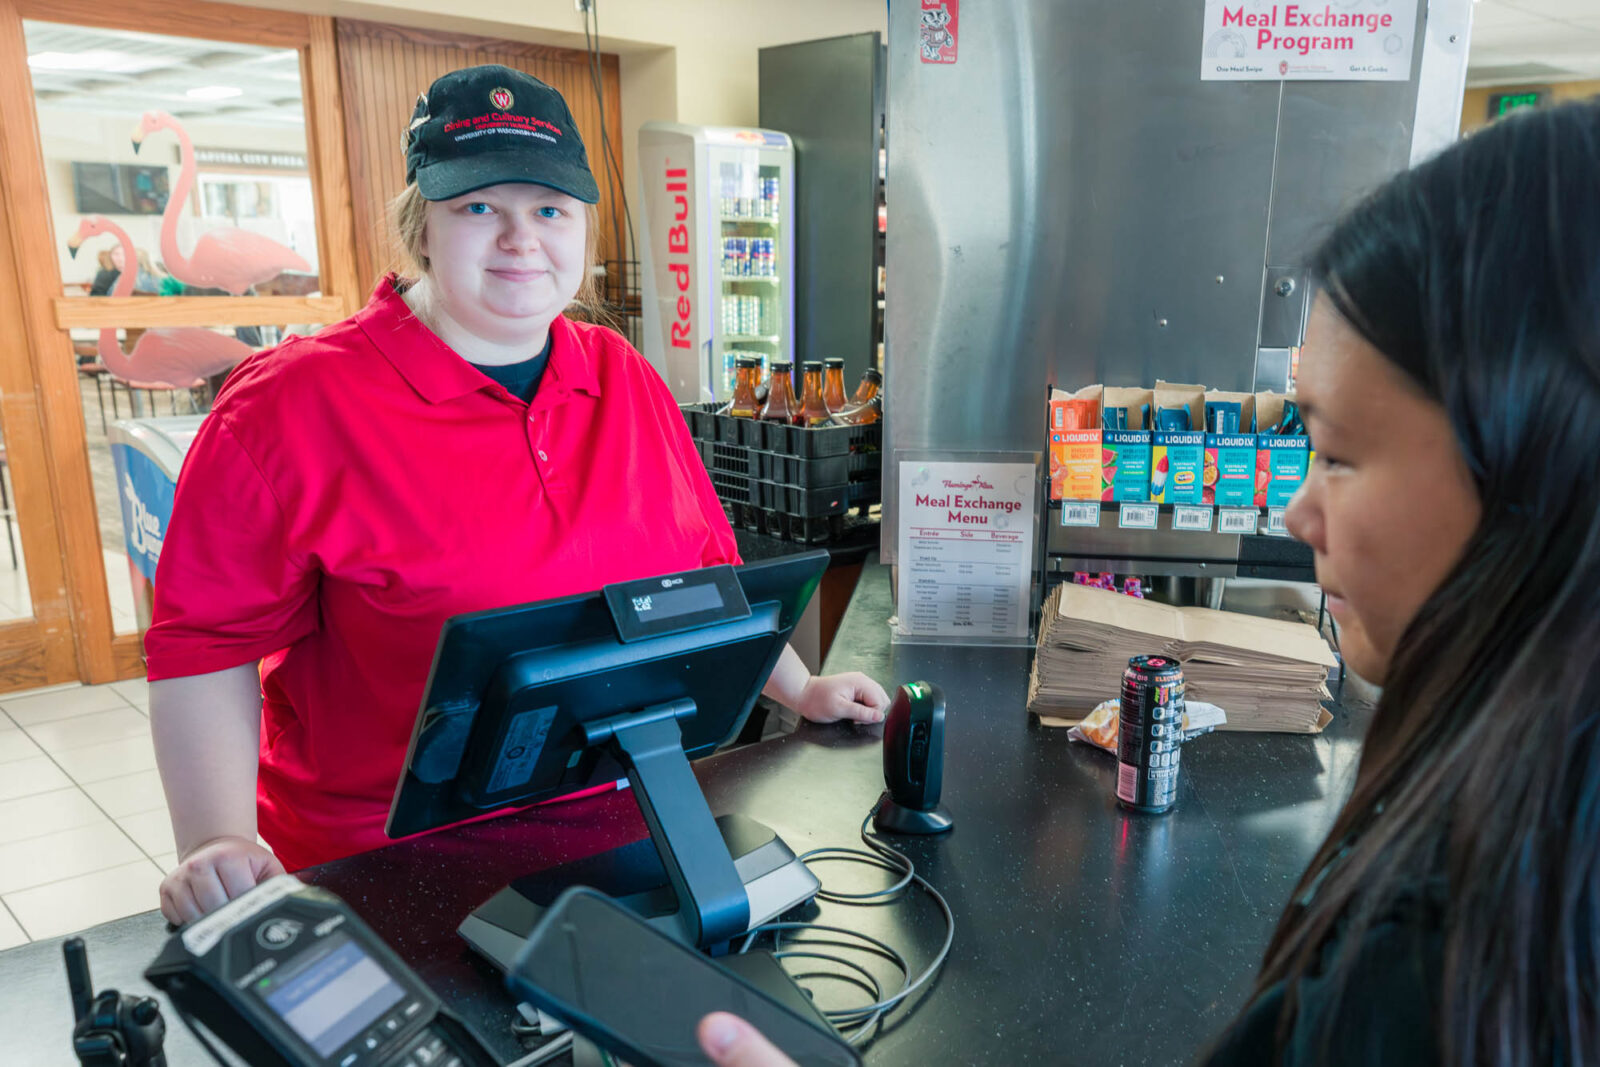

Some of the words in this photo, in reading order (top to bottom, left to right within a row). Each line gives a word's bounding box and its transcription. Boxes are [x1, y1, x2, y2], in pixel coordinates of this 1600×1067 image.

[1222, 5, 1277, 27] Meal
[1284, 5, 1393, 33] Exchange
[1256, 28, 1354, 55] Program
[1230, 65, 1245, 73] Meal
[495, 93, 509, 106] W
[444, 119, 471, 133] Dining
[472, 113, 490, 124] and
[491, 112, 530, 125] Culinary
[530, 117, 562, 136] Services
[454, 128, 487, 142] UNIVERSITY
[487, 127, 496, 135] OF
[666, 168, 689, 254] Bull
[668, 263, 691, 350] Red
[1062, 433, 1089, 443] LIQUID
[1114, 434, 1141, 443] LIQUID
[1165, 435, 1192, 444] LIQUID
[1217, 438, 1244, 446] LIQUID
[1269, 439, 1296, 447] LIQUID
[915, 494, 950, 507] Meal
[954, 495, 1022, 514] Exchange
[948, 511, 988, 525] Menu
[991, 533, 1019, 541] Beverage
